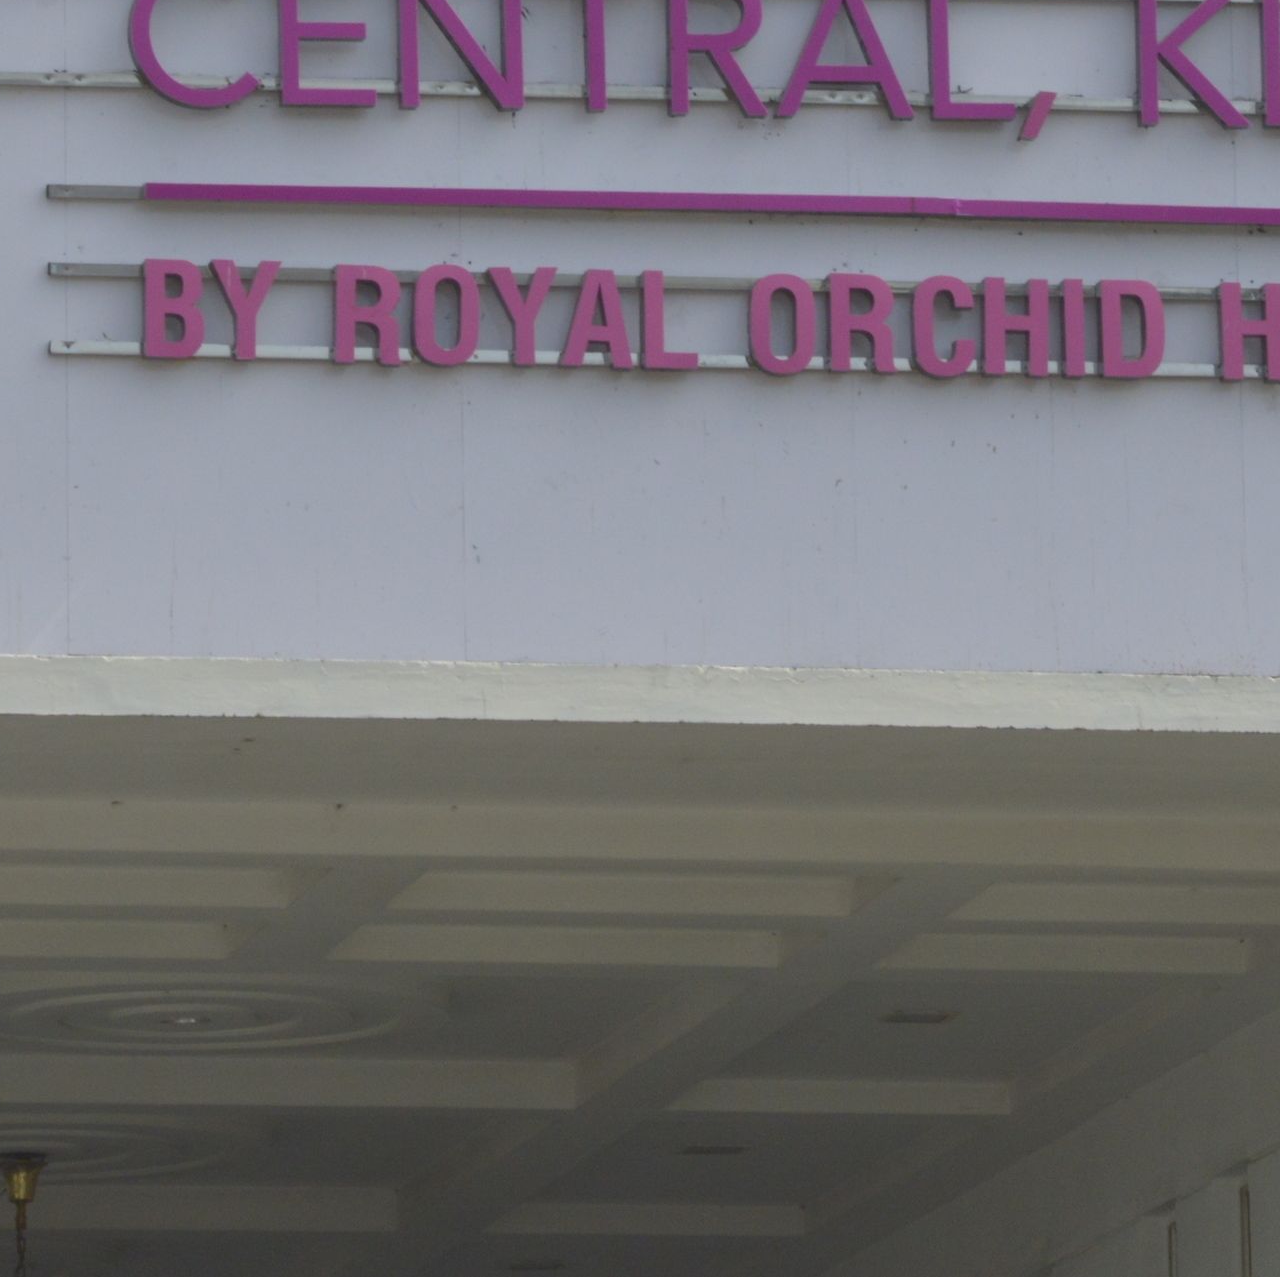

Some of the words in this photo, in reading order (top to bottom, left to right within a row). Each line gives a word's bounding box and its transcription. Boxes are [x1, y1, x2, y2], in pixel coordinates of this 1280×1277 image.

[143, 259, 280, 361] BY
[334, 264, 699, 370] ROYAL
[749, 274, 1166, 380] ORCHID
